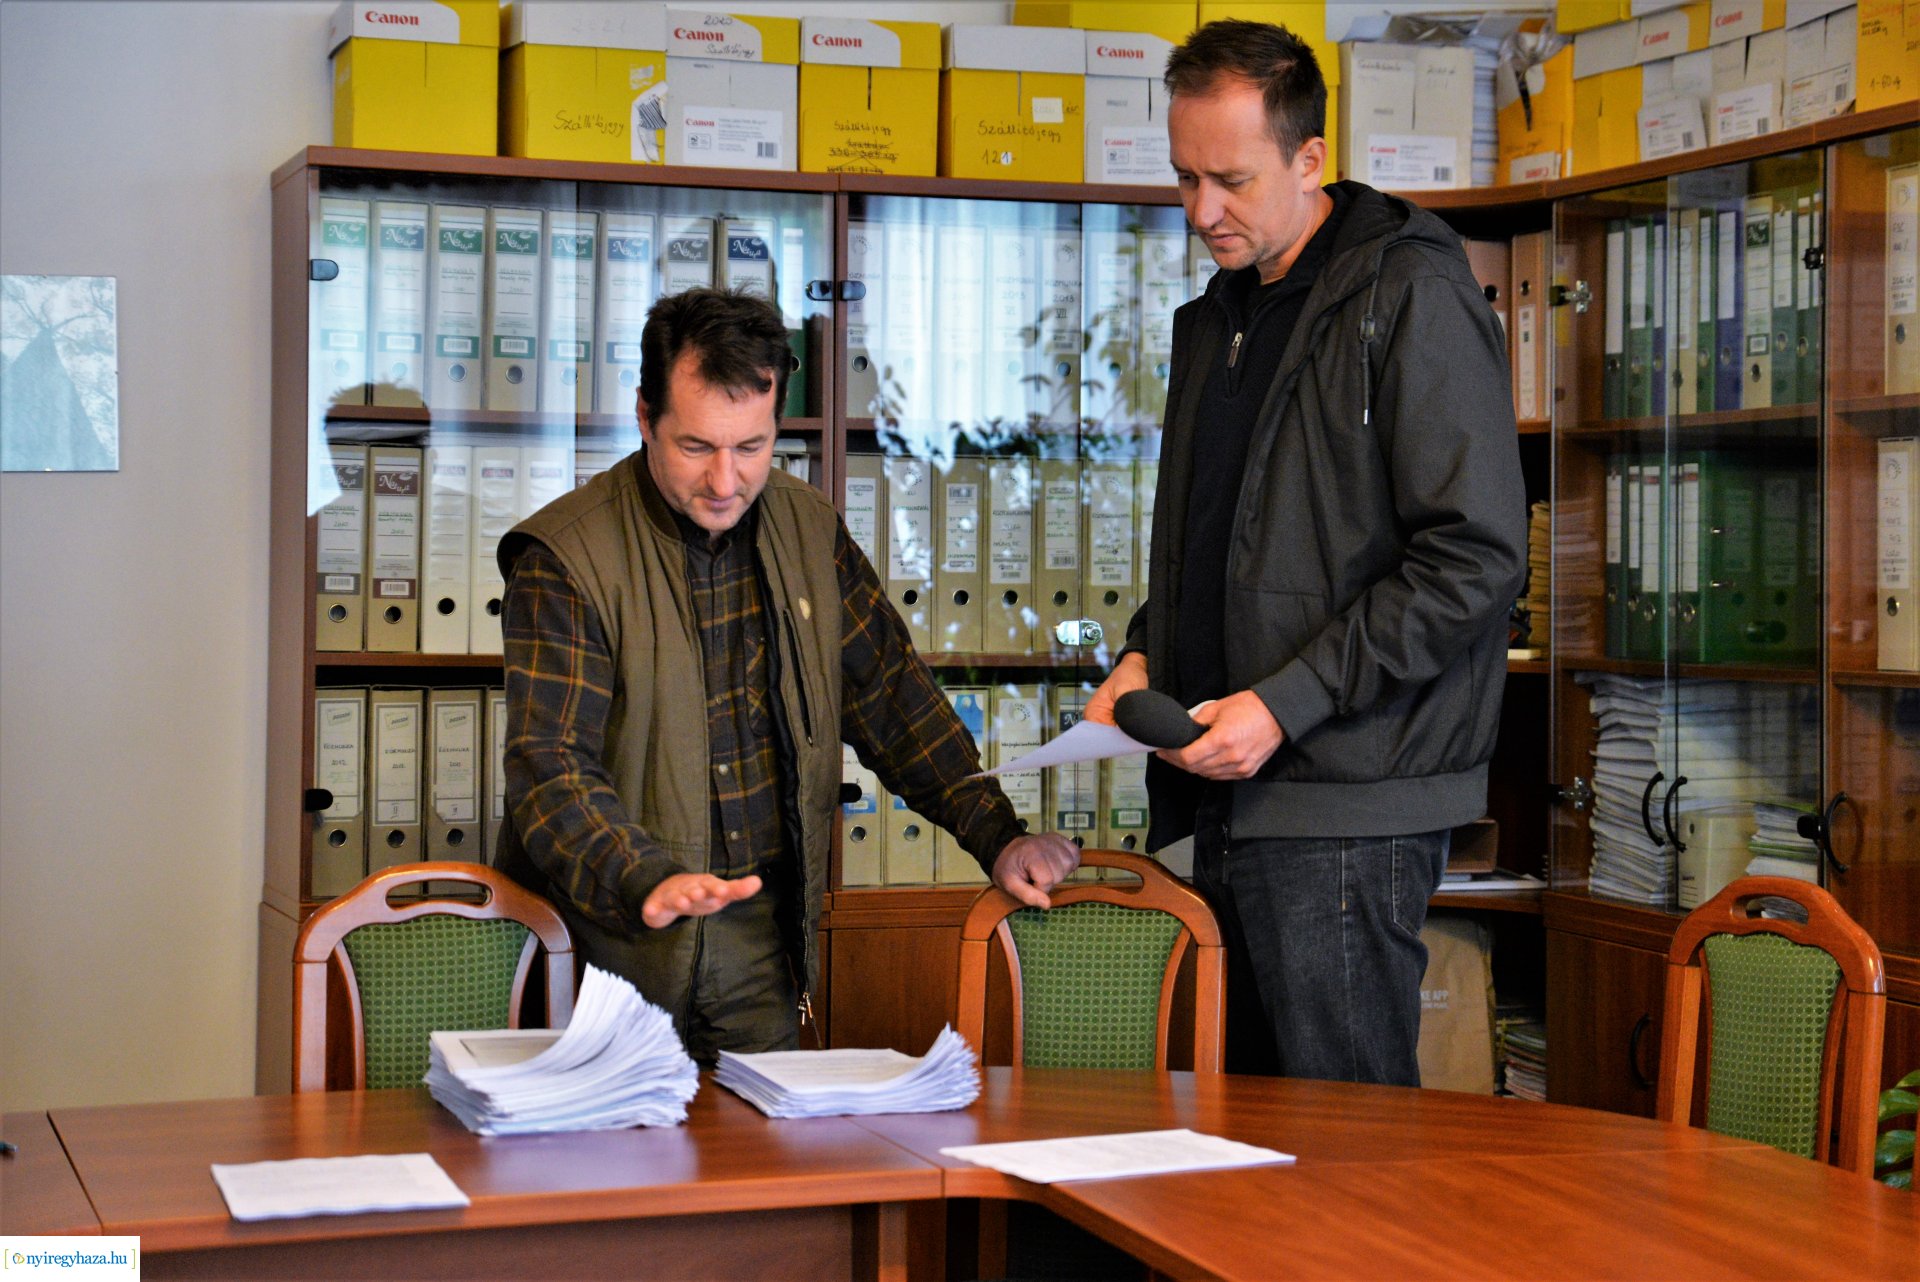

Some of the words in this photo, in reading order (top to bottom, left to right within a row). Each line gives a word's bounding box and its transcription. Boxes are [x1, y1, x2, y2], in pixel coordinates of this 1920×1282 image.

[365, 10, 419, 26] Canon
[704, 14, 733, 26] 2020
[674, 27, 724, 42] Canon
[812, 33, 863, 48] Canon
[1643, 31, 1670, 46] Canon
[1096, 45, 1145, 60] Canon
[685, 118, 715, 128] Canon
